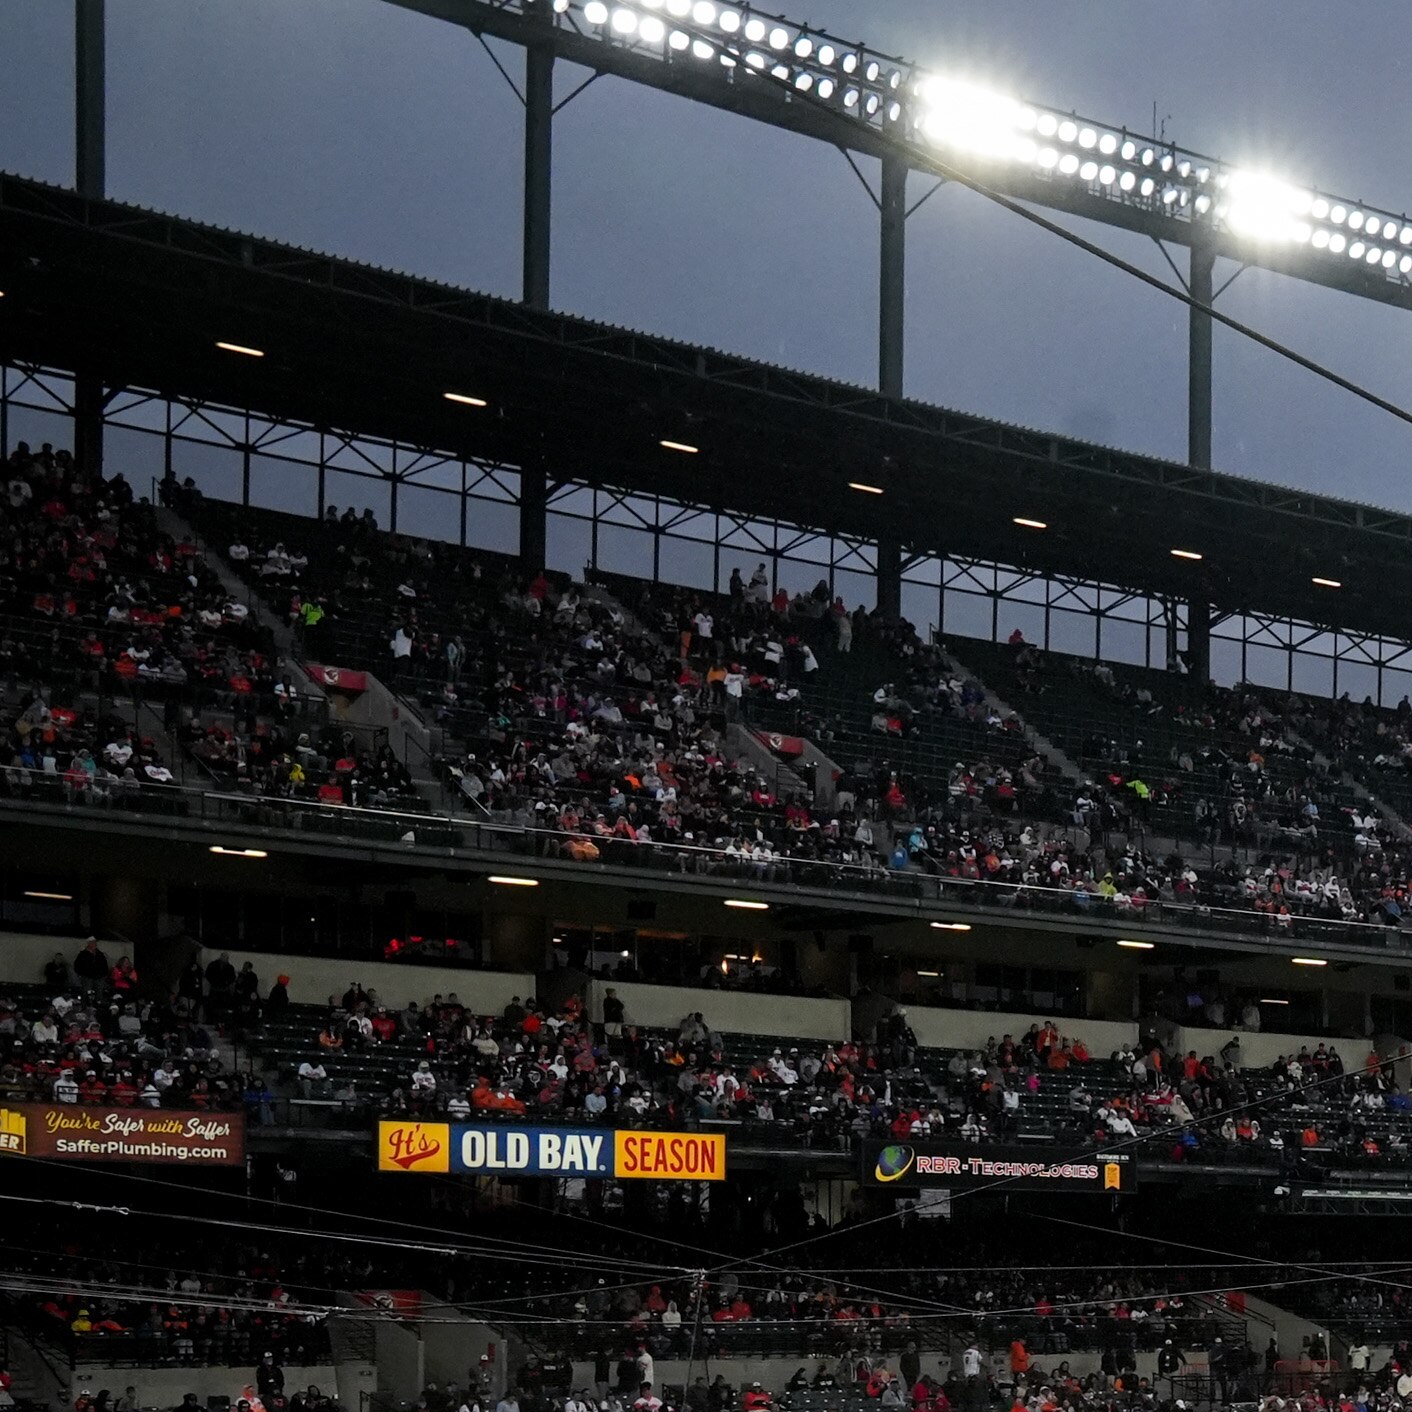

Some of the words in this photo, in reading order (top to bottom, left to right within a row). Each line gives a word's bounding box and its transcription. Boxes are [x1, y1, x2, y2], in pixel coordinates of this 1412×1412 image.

[46, 1111, 100, 1133] You're
[101, 1113, 145, 1137] Safer
[147, 1119, 182, 1134] with
[183, 1117, 230, 1140] Saffer
[56, 1139, 227, 1159] SafferPlumbing.com
[389, 1123, 441, 1167] It's
[461, 1130, 529, 1169] OLD
[623, 1136, 716, 1174] SEASON
